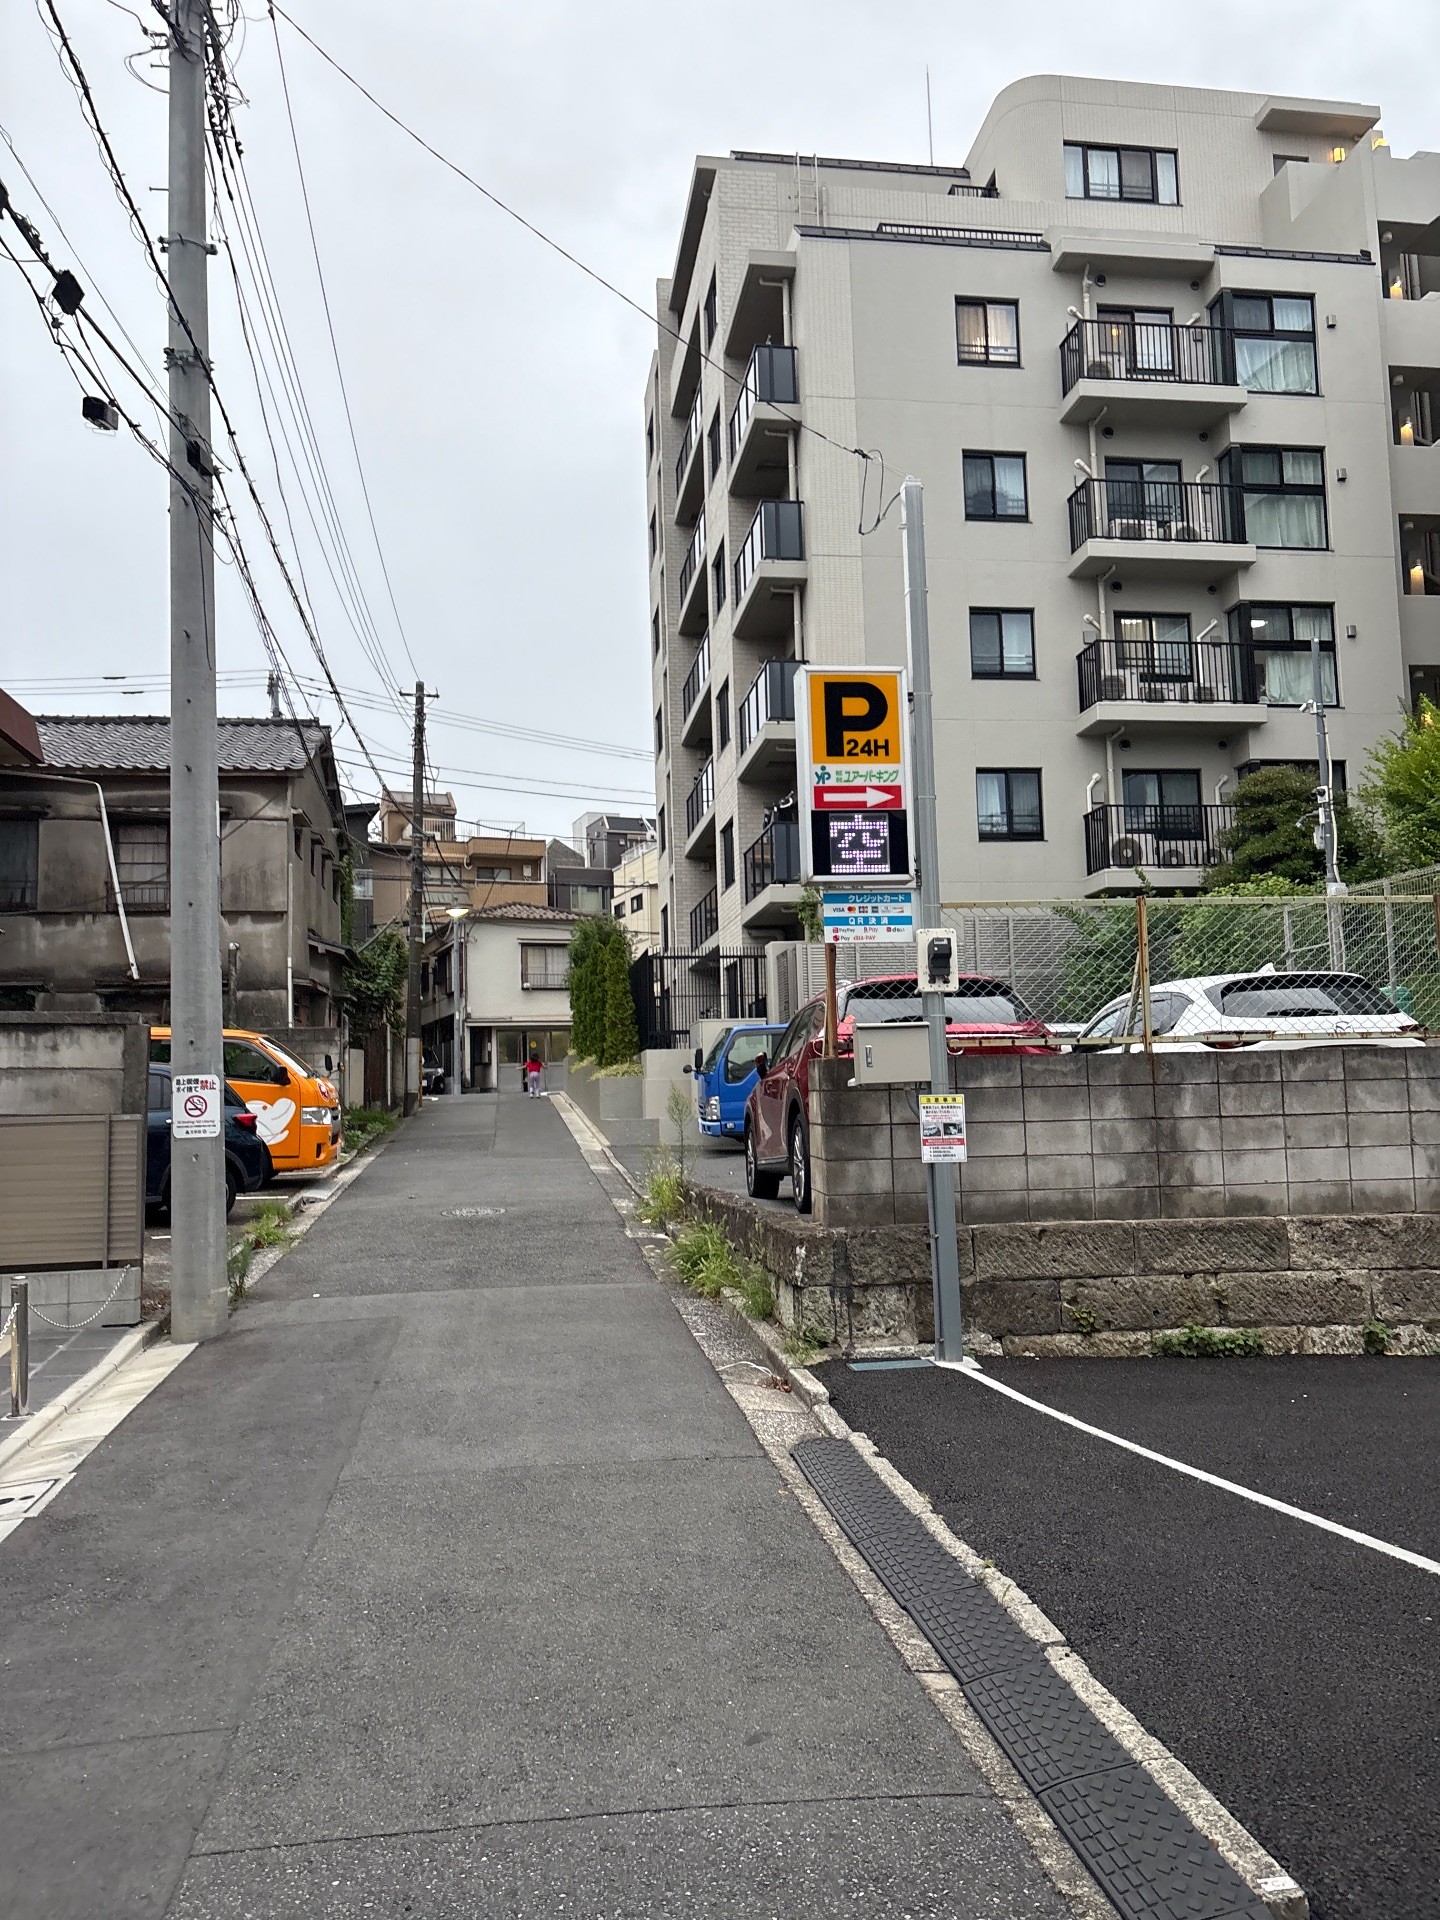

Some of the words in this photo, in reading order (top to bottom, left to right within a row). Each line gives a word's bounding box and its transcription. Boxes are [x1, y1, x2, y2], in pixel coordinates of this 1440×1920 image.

[823, 681, 889, 757] P
[846, 738, 890, 757] 24H
[829, 814, 890, 873] 空
[848, 894, 905, 903] クレジットカード
[200, 1079, 216, 1090] 禁止
